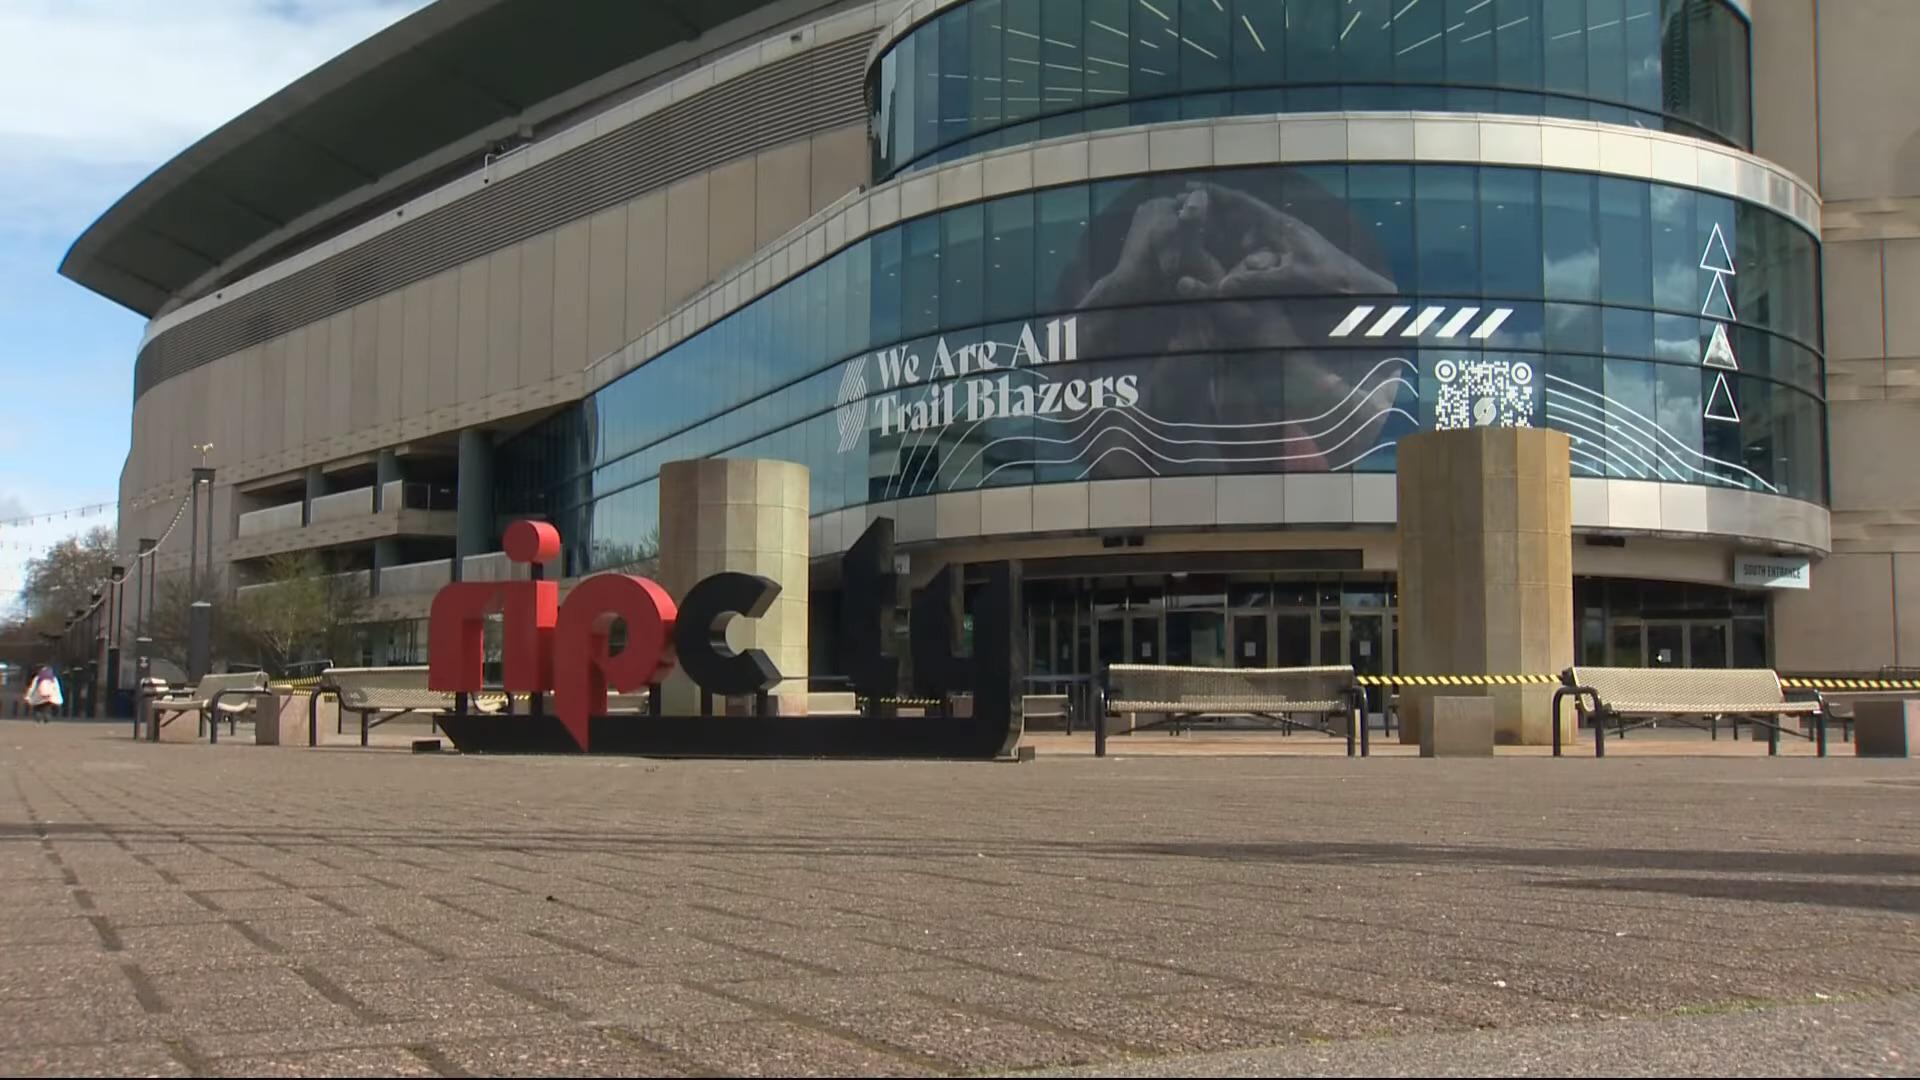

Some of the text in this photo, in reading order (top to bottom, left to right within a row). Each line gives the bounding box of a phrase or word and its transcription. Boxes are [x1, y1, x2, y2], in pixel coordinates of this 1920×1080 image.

[876, 316, 1077, 388] We Are All
[875, 374, 1139, 436] Trail Blazers
[1744, 564, 1800, 579] SOUTH ENTRANCE
